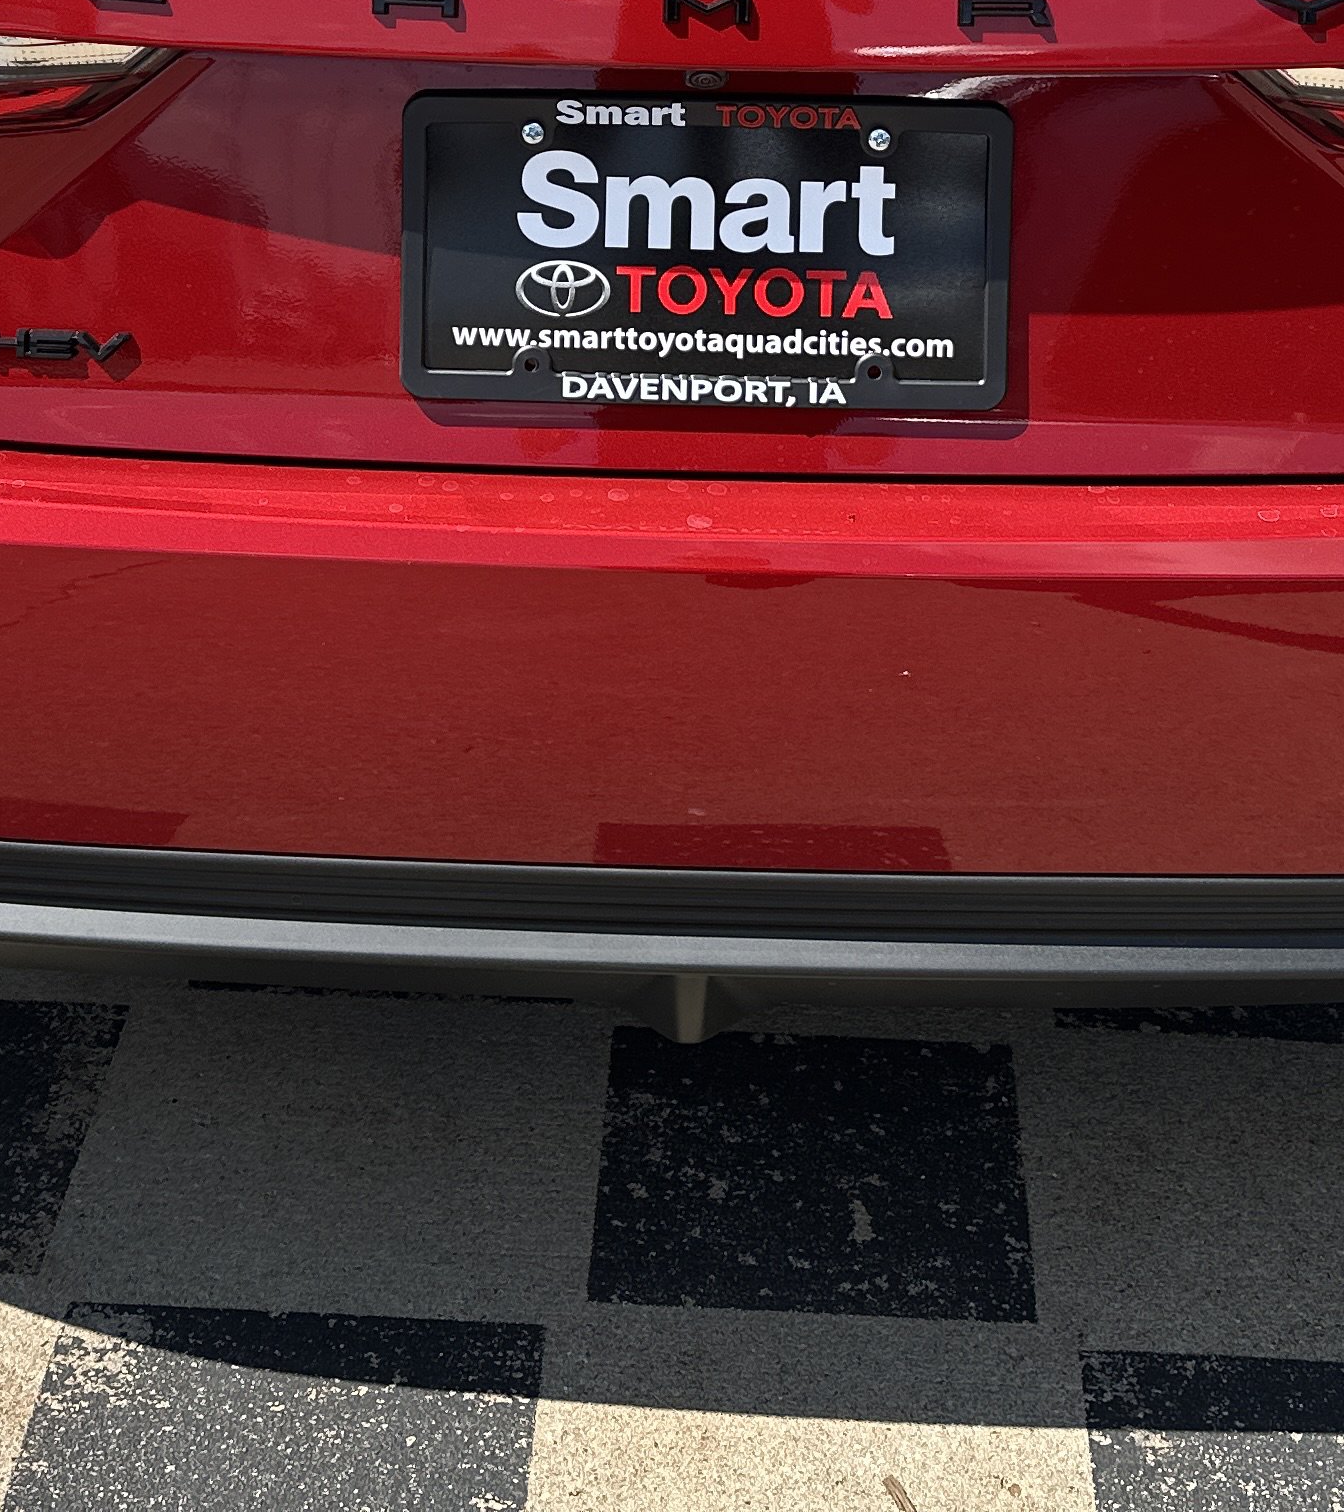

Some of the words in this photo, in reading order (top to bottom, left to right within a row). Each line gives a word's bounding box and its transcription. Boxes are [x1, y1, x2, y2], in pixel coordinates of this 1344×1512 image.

[556, 99, 686, 127] Smart
[715, 104, 862, 130] TOYOTA
[517, 150, 896, 256] Smart
[616, 265, 894, 320] TOYOTA
[452, 325, 954, 358] www.smarttoyotaquadcities.com
[562, 375, 796, 408] DAVENPORT,
[807, 376, 847, 405] IA
